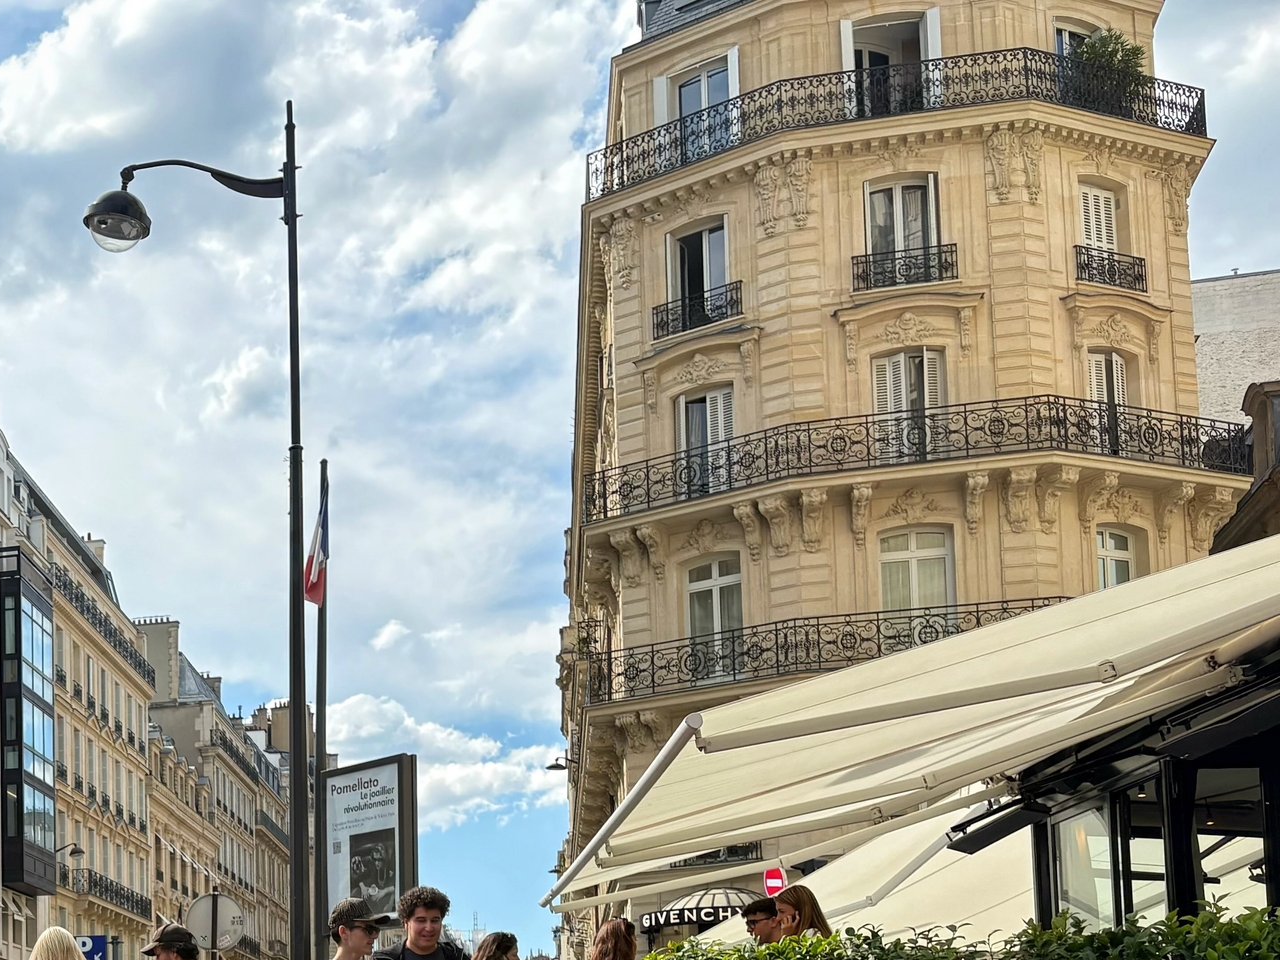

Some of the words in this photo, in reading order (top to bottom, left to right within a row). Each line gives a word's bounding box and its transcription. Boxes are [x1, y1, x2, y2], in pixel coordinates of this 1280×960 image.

[331, 778, 379, 797] Pomellato
[360, 791, 369, 800] Le
[369, 785, 395, 800] joaillier
[343, 796, 395, 815] révolutionnaire
[642, 906, 744, 928] GIVENCH
